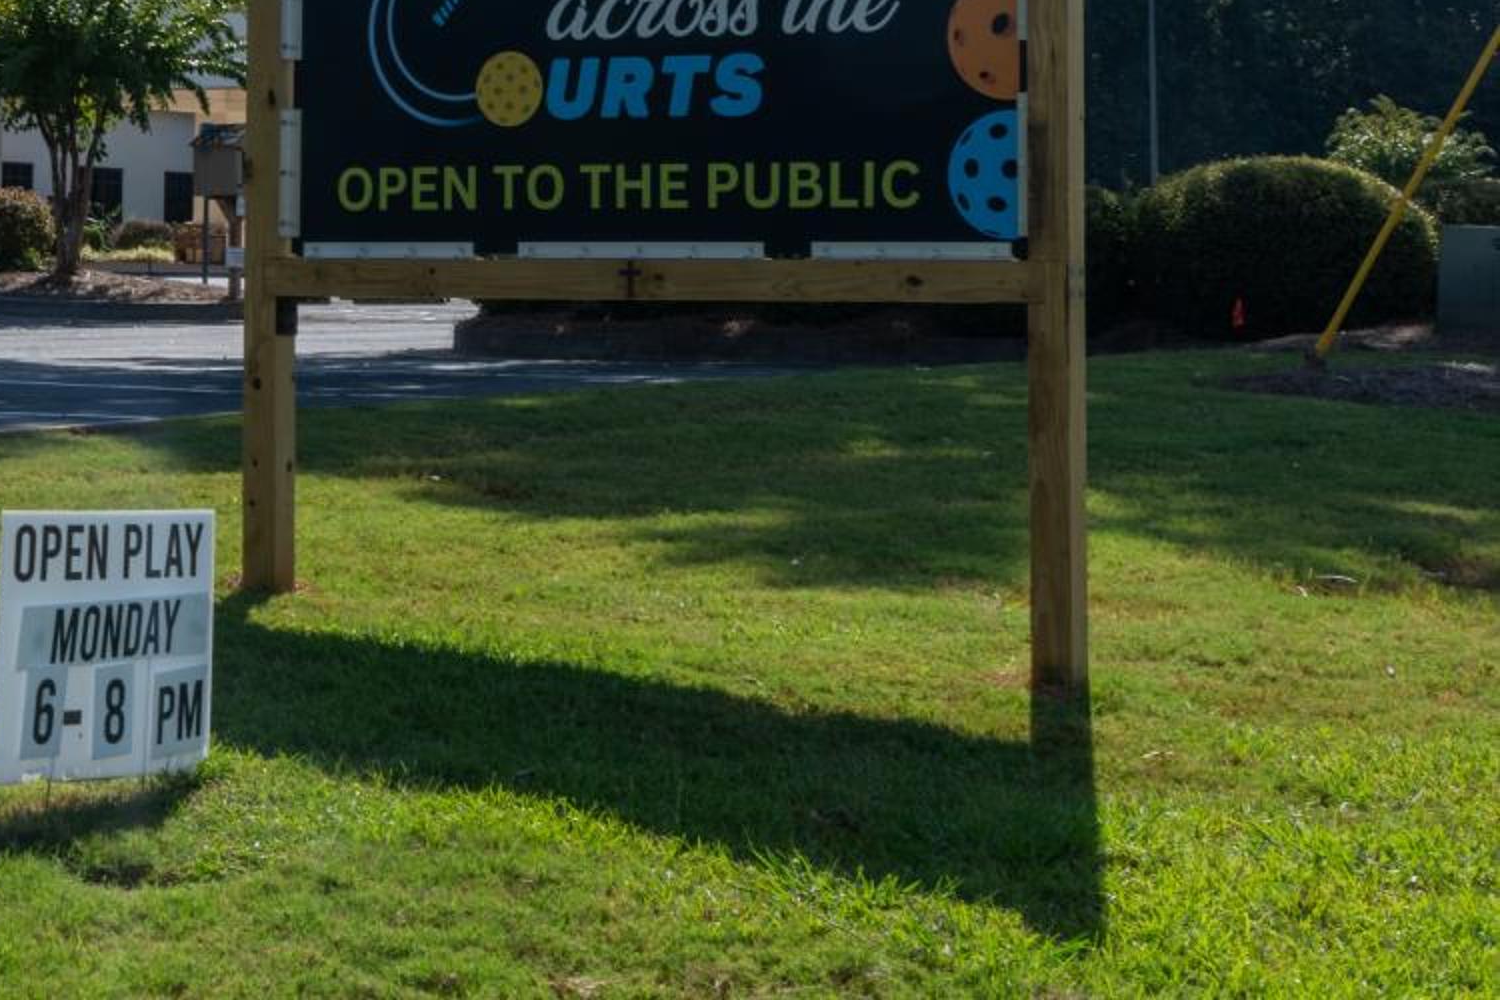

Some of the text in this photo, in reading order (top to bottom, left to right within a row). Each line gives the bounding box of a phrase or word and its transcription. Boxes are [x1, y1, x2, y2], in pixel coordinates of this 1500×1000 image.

[337, 160, 921, 212] OPEN TO THE PUBLIC
[13, 522, 204, 582] OPEN PLAY
[50, 599, 181, 665] MONDAY
[156, 679, 204, 745] PM
